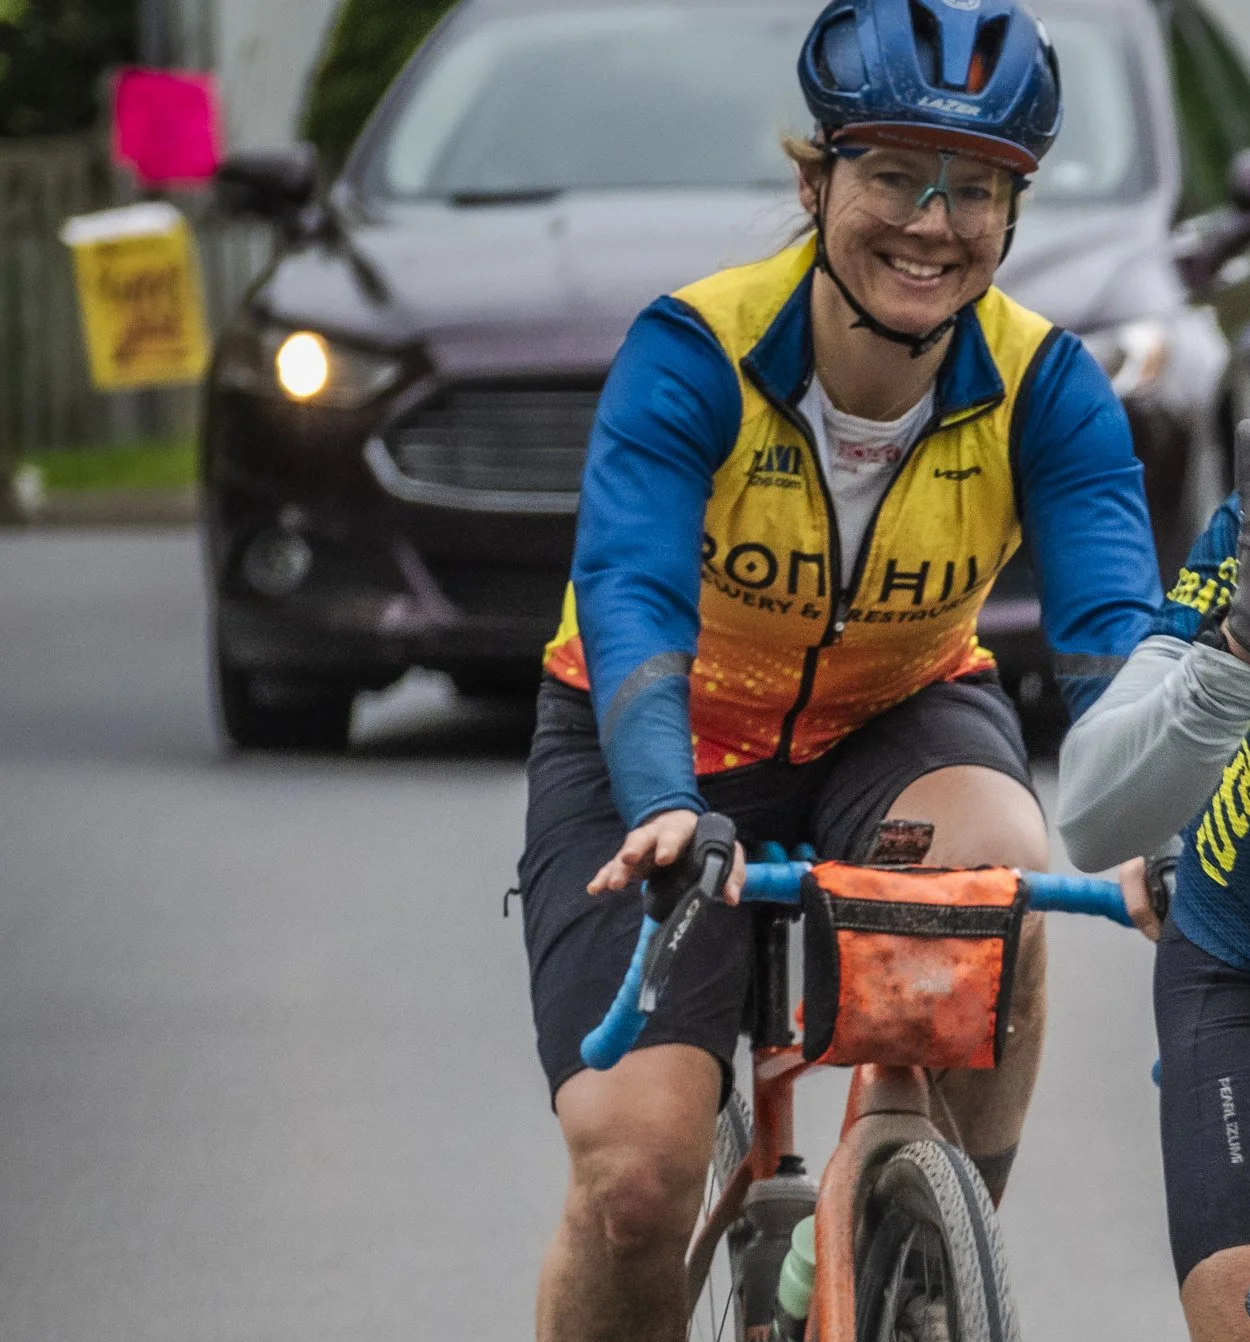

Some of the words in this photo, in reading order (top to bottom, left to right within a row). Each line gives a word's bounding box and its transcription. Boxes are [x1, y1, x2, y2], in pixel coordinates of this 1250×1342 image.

[917, 96, 981, 116] LAZER
[801, 602, 823, 620] &
[1218, 1076, 1236, 1122] PEARL
